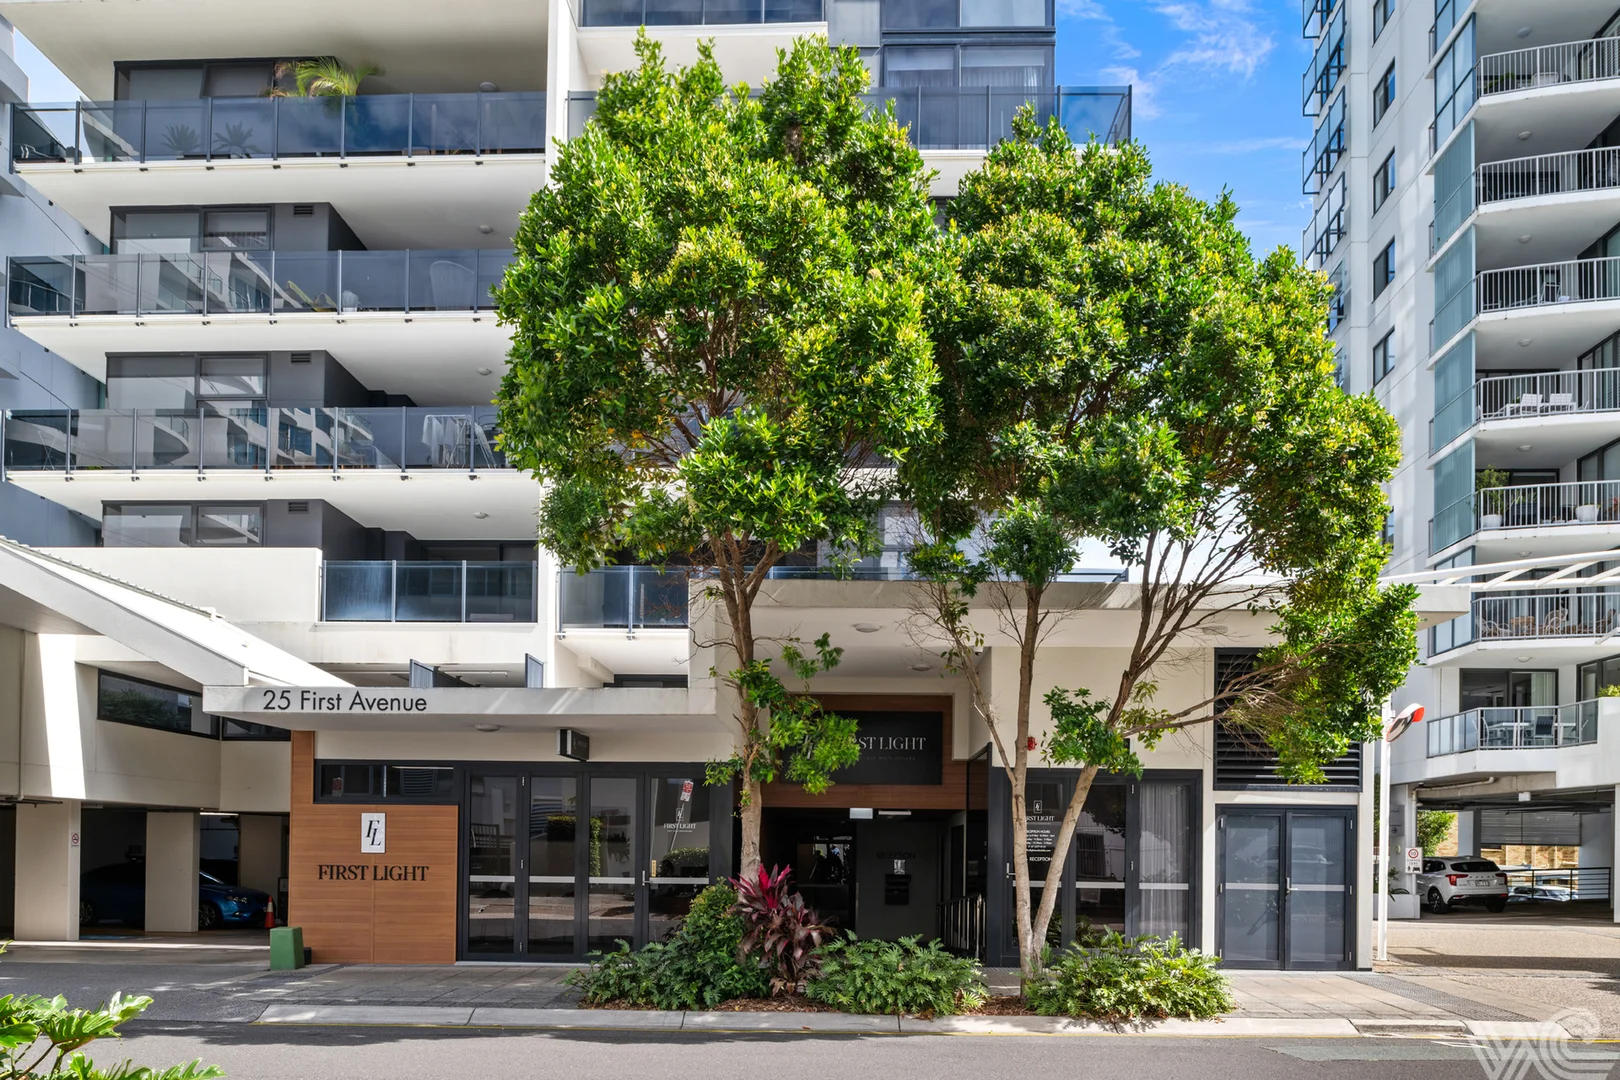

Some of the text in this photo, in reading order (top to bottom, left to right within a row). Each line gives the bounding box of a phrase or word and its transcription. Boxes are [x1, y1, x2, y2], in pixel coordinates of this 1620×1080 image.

[262, 689, 428, 712] 25 First Avenue
[879, 736, 927, 750] LIGHT
[317, 864, 429, 882] FIRST LIGHT
